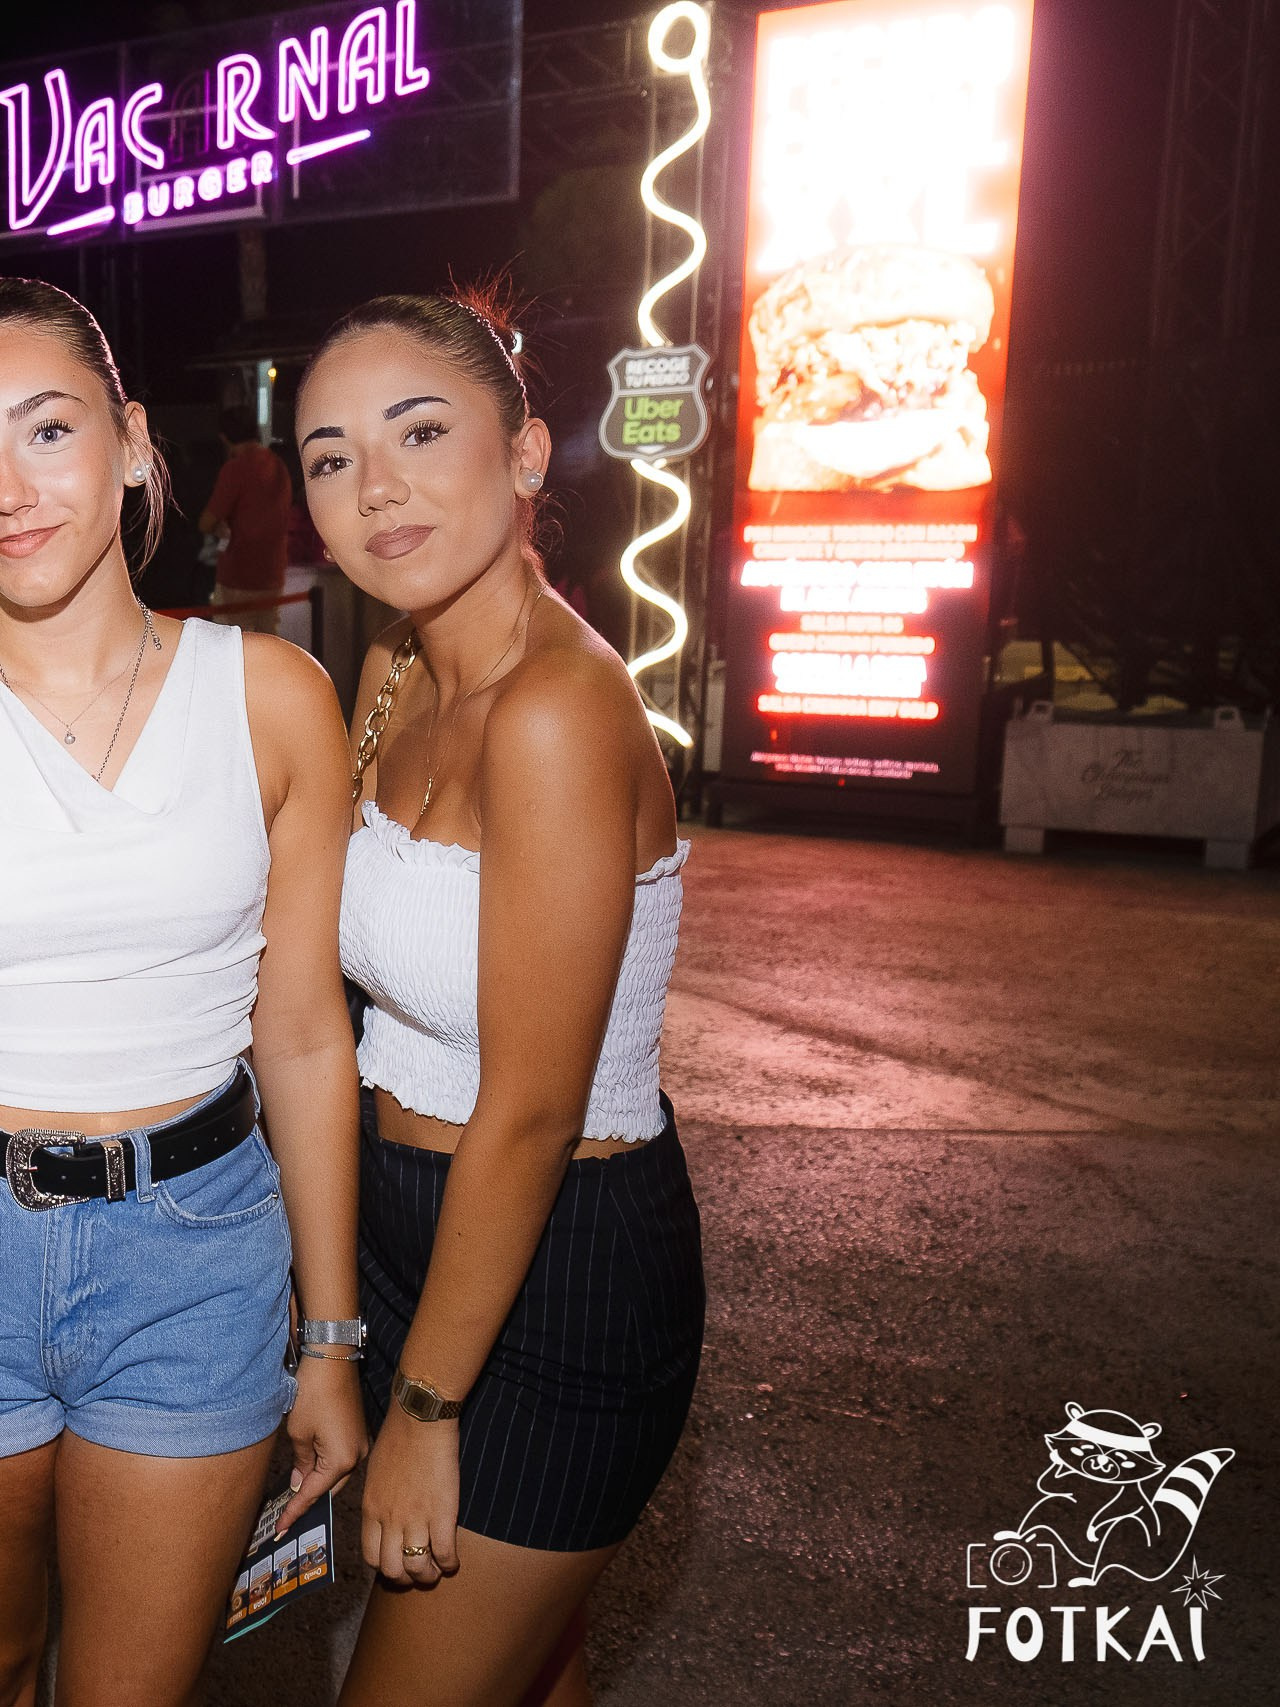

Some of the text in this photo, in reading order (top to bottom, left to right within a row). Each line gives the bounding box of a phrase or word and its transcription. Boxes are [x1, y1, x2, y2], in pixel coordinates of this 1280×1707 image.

[122, 150, 276, 226] BURGER
[624, 395, 684, 420] Uber
[622, 420, 682, 445] Eats
